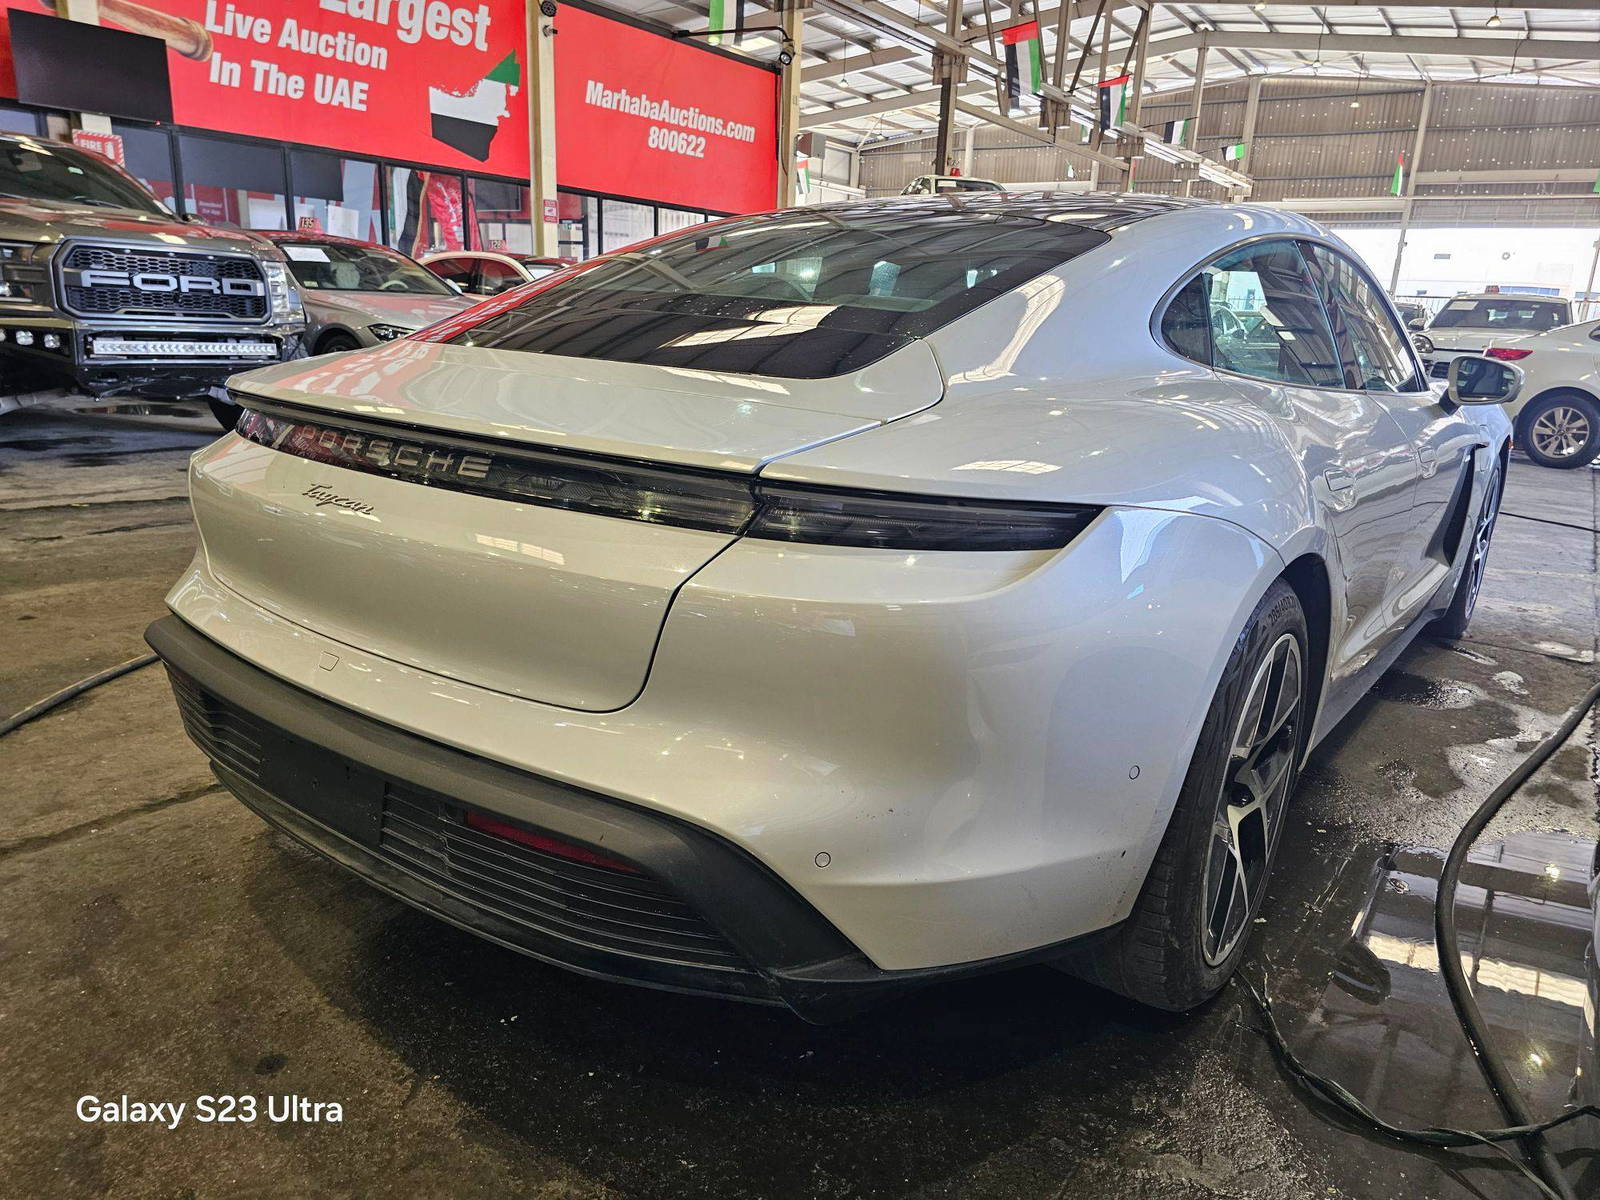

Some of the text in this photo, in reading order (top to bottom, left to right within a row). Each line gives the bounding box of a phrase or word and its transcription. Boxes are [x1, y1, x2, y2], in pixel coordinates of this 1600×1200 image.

[204, 0, 388, 71] Live Auction
[319, 0, 491, 52] rgest
[209, 52, 369, 112] In The UAE
[585, 80, 756, 143] MarhabaAuctions.com
[648, 126, 706, 158] 800622
[80, 269, 265, 296] FORD
[300, 424, 493, 479] PORSCHE
[302, 483, 374, 515] Taycan
